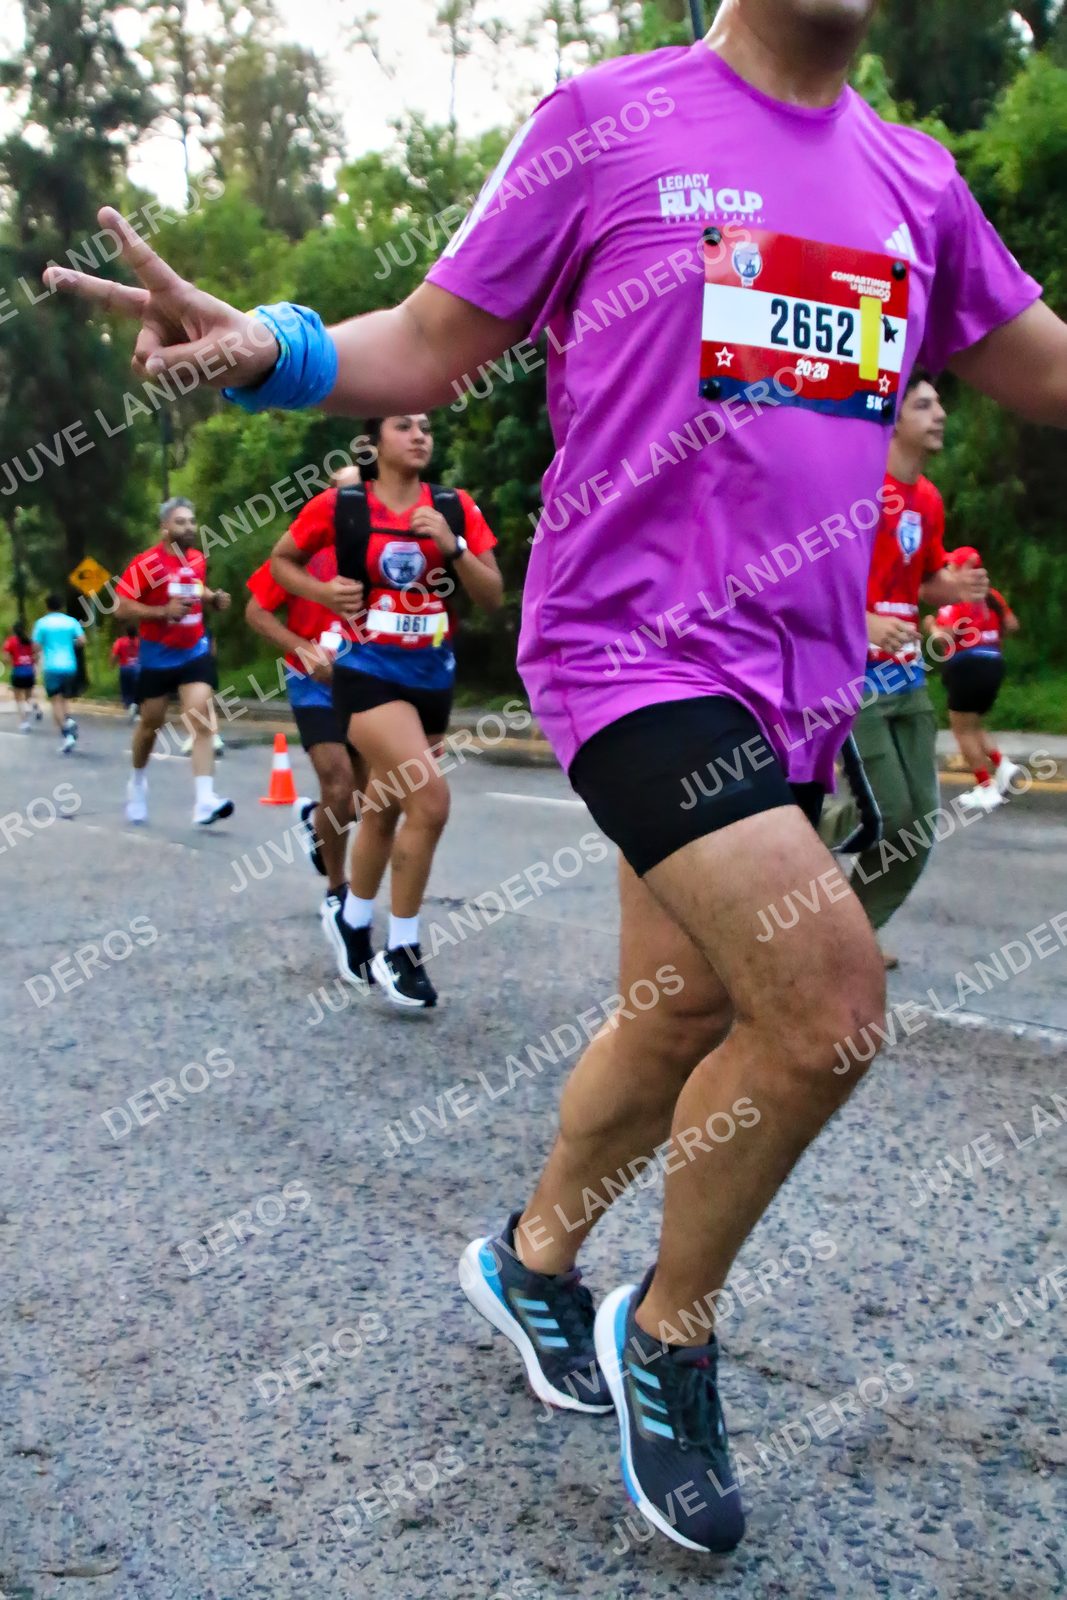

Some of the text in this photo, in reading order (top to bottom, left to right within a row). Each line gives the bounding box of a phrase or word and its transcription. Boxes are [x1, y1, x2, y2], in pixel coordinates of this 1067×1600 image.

[658, 173, 709, 192] LEGACY
[660, 187, 763, 217] RUN CUP
[771, 298, 854, 357] 2652
[866, 395, 884, 410] 5K
